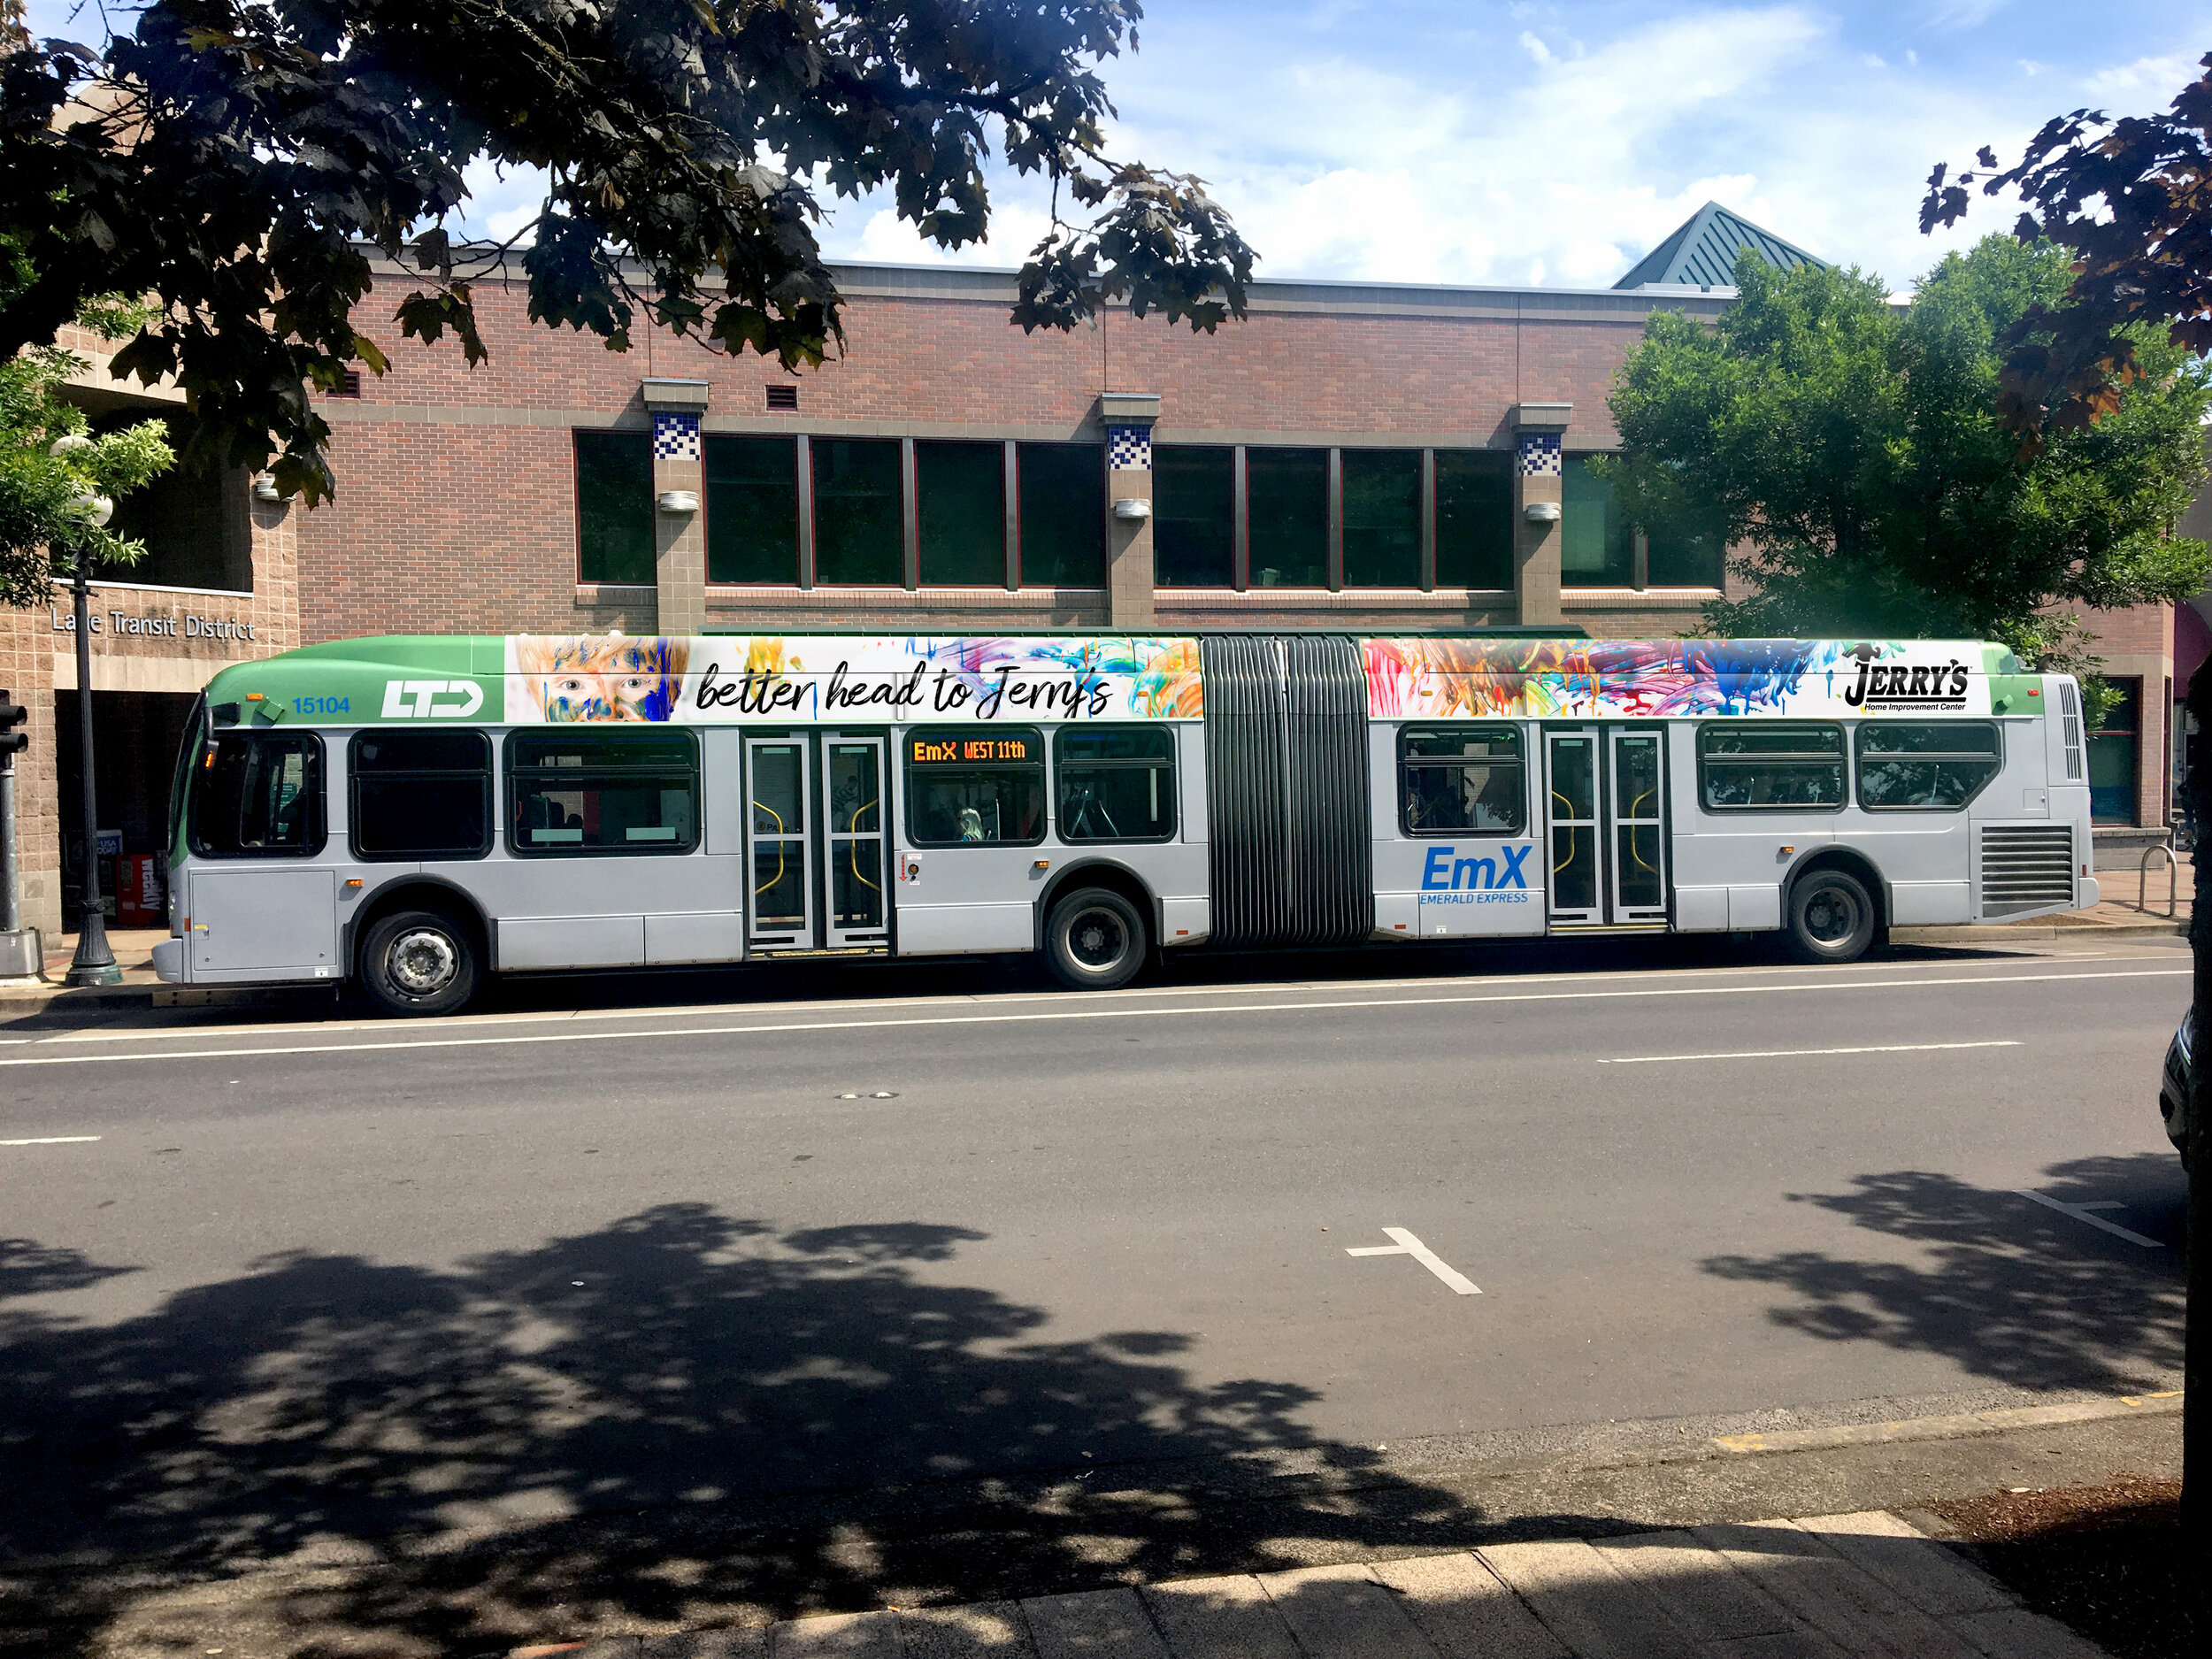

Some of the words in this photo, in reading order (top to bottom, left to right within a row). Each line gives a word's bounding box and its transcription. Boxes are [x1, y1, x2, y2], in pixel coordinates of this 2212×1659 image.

[51, 607, 103, 632] Lae
[111, 611, 177, 636] Transit
[186, 615, 256, 641] District
[380, 680, 484, 718] LTD
[696, 662, 818, 714] better
[826, 660, 926, 710] head
[933, 665, 974, 712] to
[293, 696, 350, 714] 15104
[913, 741, 956, 762] EmX
[964, 741, 994, 759] WEST
[997, 741, 1025, 758] 11th
[766, 824, 789, 833] PAS
[1421, 846, 1532, 890] EmX
[1420, 894, 1474, 904] EMERALD
[1477, 893, 1528, 903] EXPRESS
